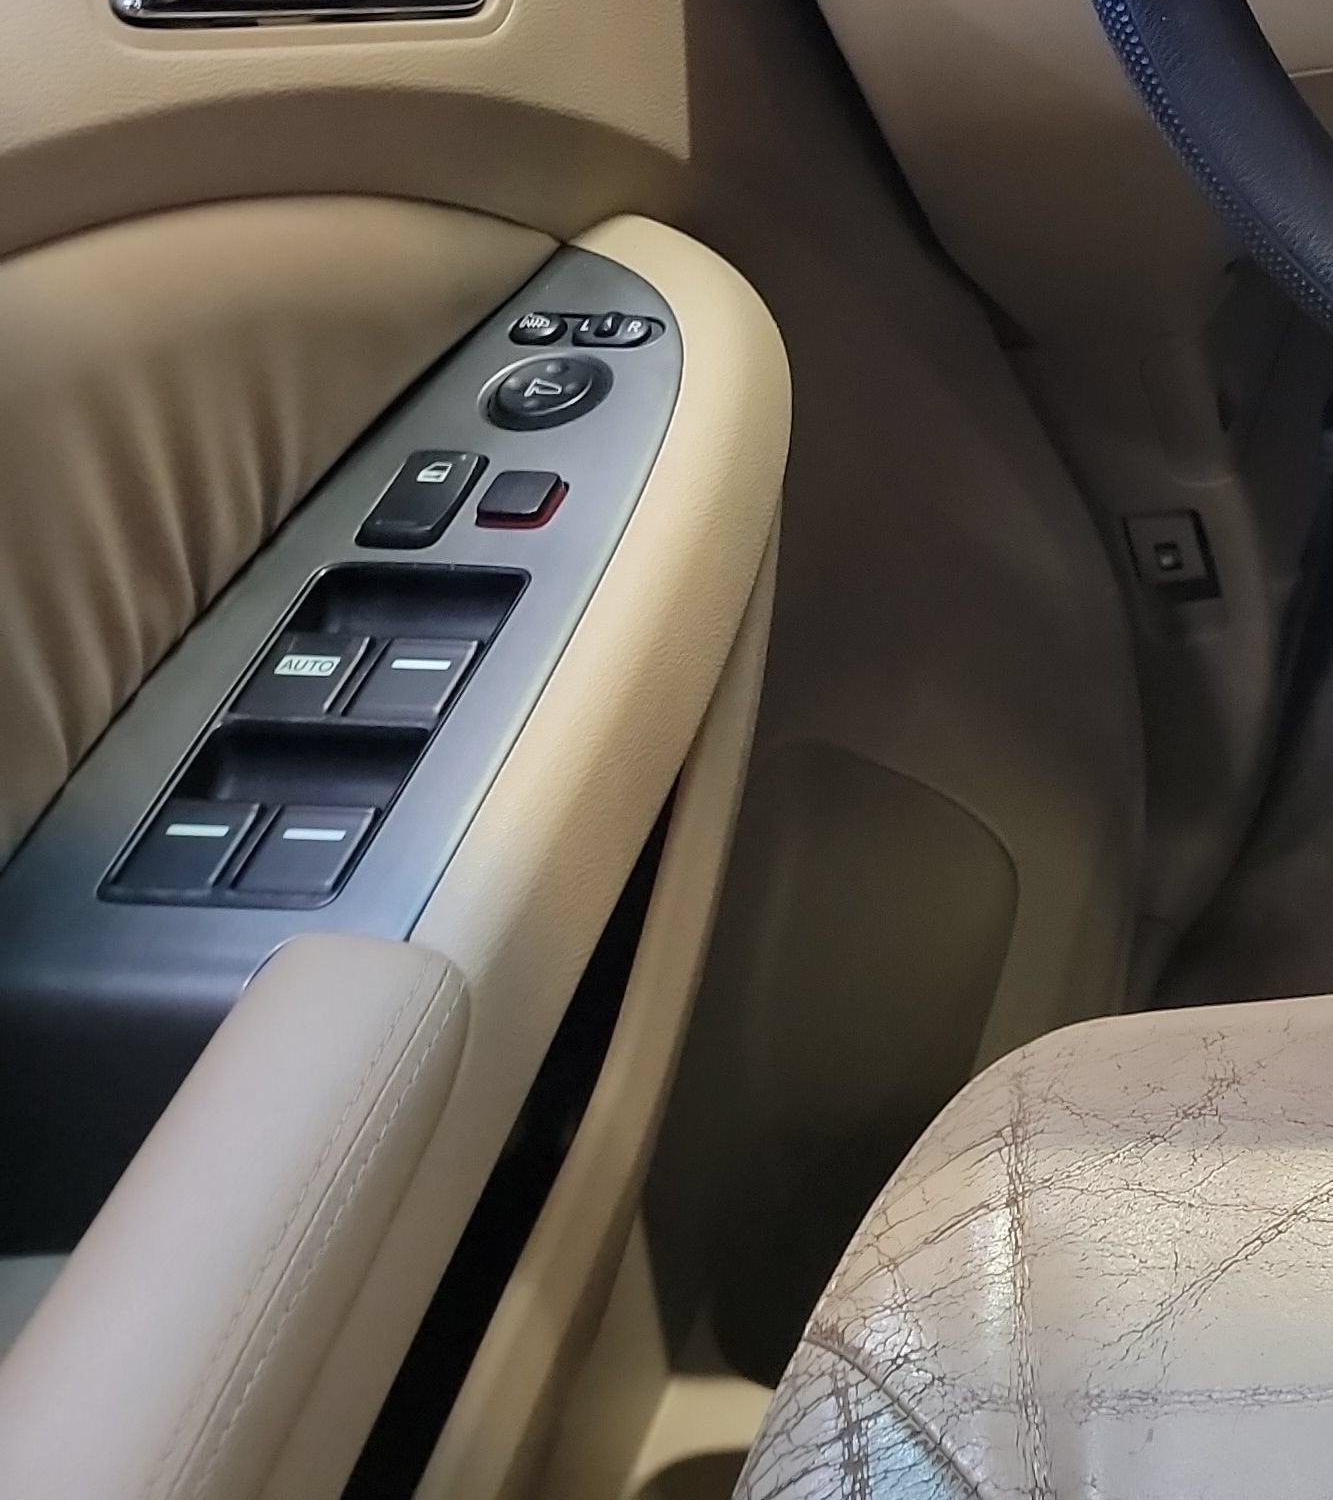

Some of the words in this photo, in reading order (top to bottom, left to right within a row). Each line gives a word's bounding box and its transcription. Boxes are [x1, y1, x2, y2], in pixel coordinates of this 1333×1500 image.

[580, 318, 590, 332] L
[627, 320, 642, 333] R
[280, 659, 335, 673] AUTO
